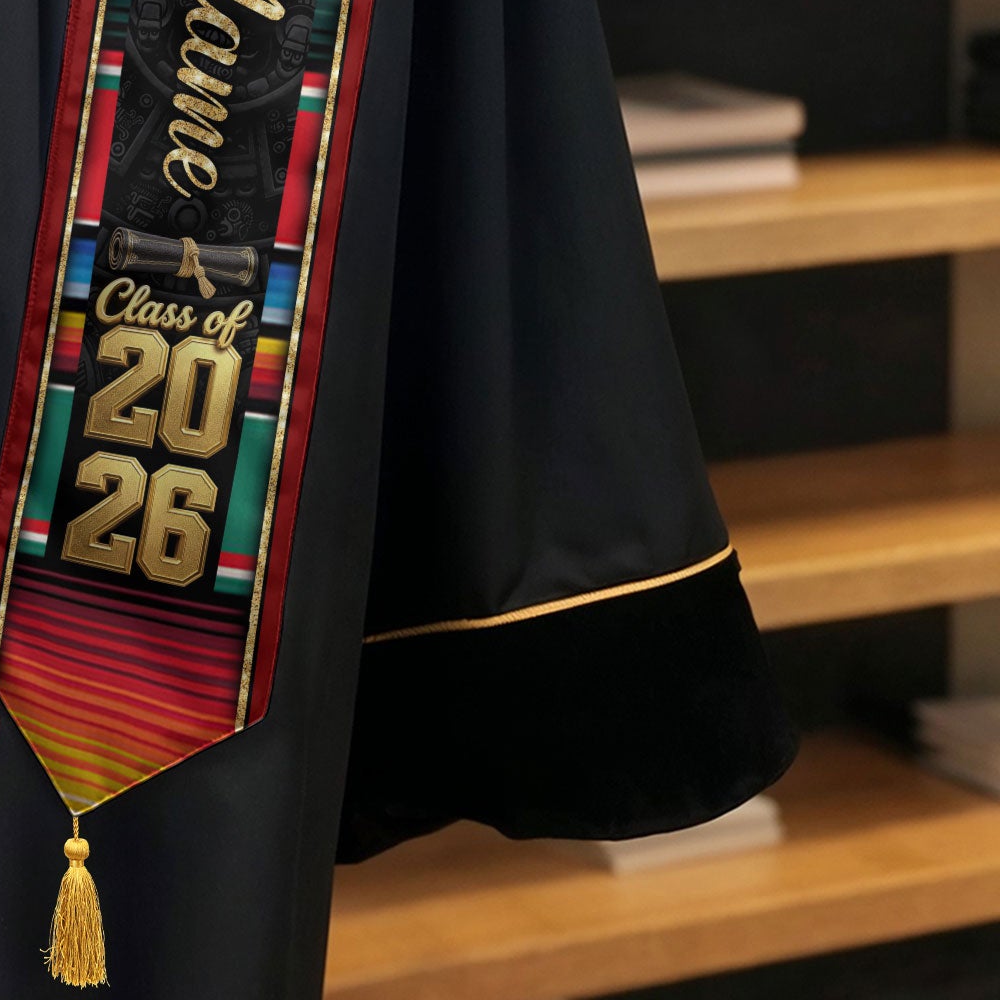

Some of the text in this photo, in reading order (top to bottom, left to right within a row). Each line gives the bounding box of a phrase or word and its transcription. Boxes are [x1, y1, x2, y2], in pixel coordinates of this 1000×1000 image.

[95, 277, 254, 350] Class of
[83, 325, 243, 460] 20
[60, 450, 220, 589] 26
